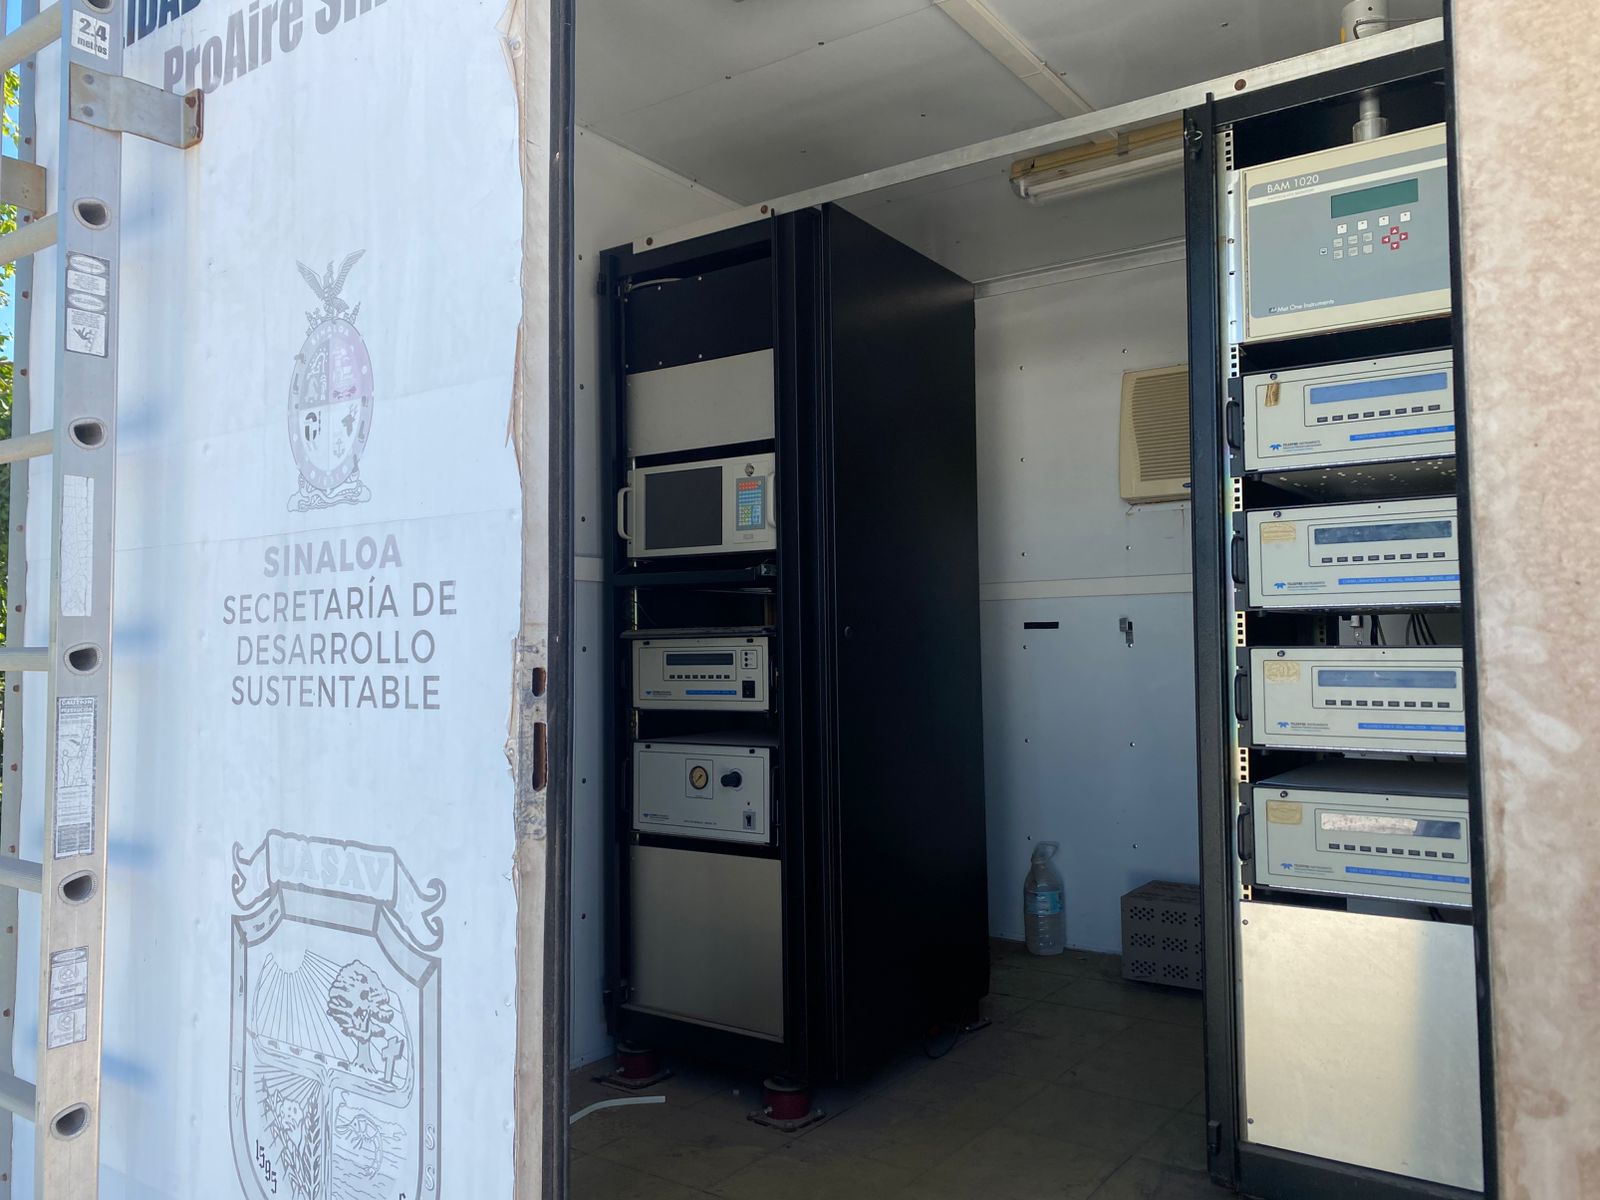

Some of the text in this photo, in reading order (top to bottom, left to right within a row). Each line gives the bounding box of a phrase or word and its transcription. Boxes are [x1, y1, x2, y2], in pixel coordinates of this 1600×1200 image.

[76, 36, 108, 56] metros
[78, 17, 108, 43] 2.4
[1267, 174, 1319, 193] BAM 1020
[263, 534, 402, 578] SINALOA
[222, 576, 457, 625] SECRETARÍA DE
[236, 629, 436, 666] DESARROLLO
[231, 675, 441, 710] SUSTENTABLE
